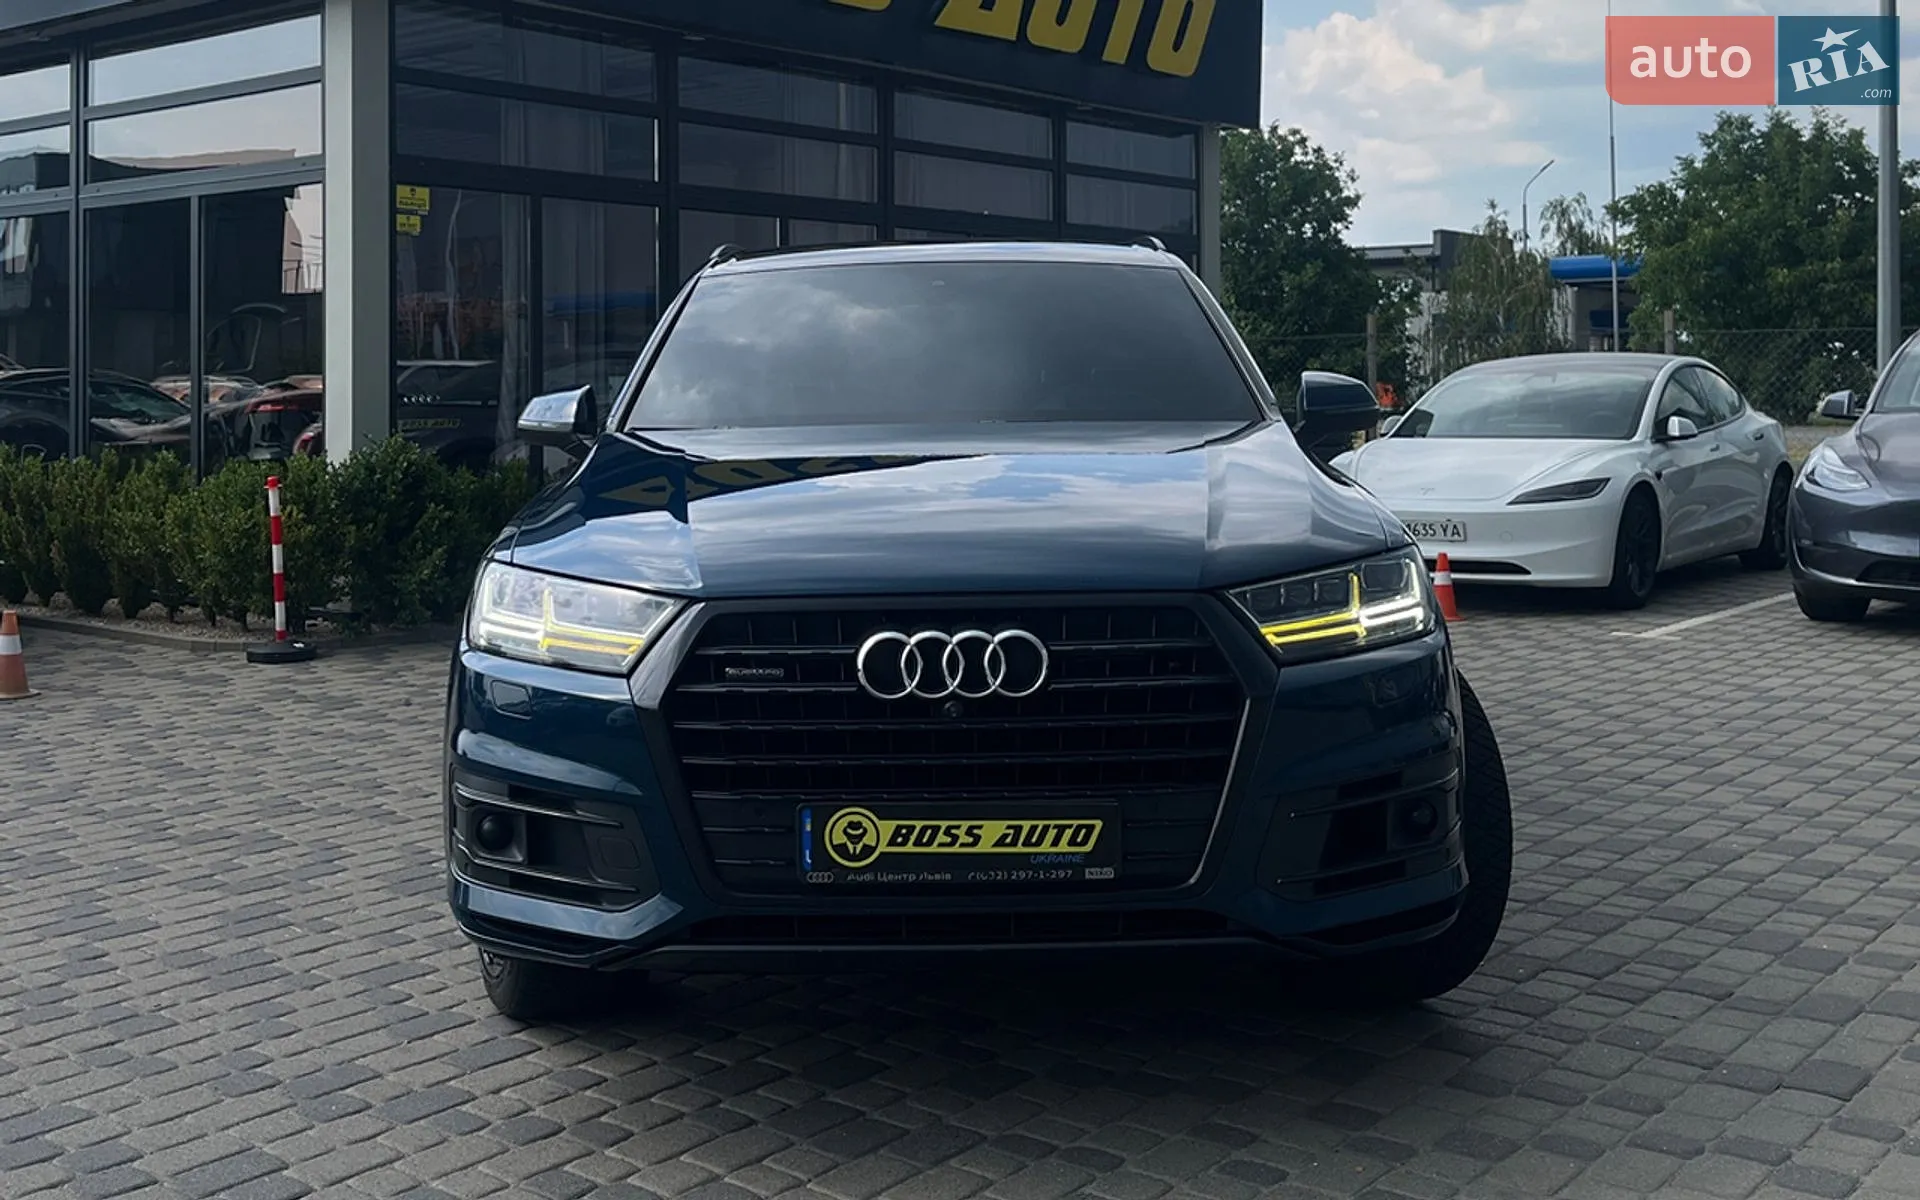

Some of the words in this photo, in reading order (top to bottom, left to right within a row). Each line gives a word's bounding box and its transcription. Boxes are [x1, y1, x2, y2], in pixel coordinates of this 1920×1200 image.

[1440, 523, 1462, 538] YA
[886, 823, 985, 848] BOSS
[990, 823, 1097, 848] AUTO
[1030, 854, 1085, 864] UKRAINE
[1011, 869, 1074, 880] 297-1-297
